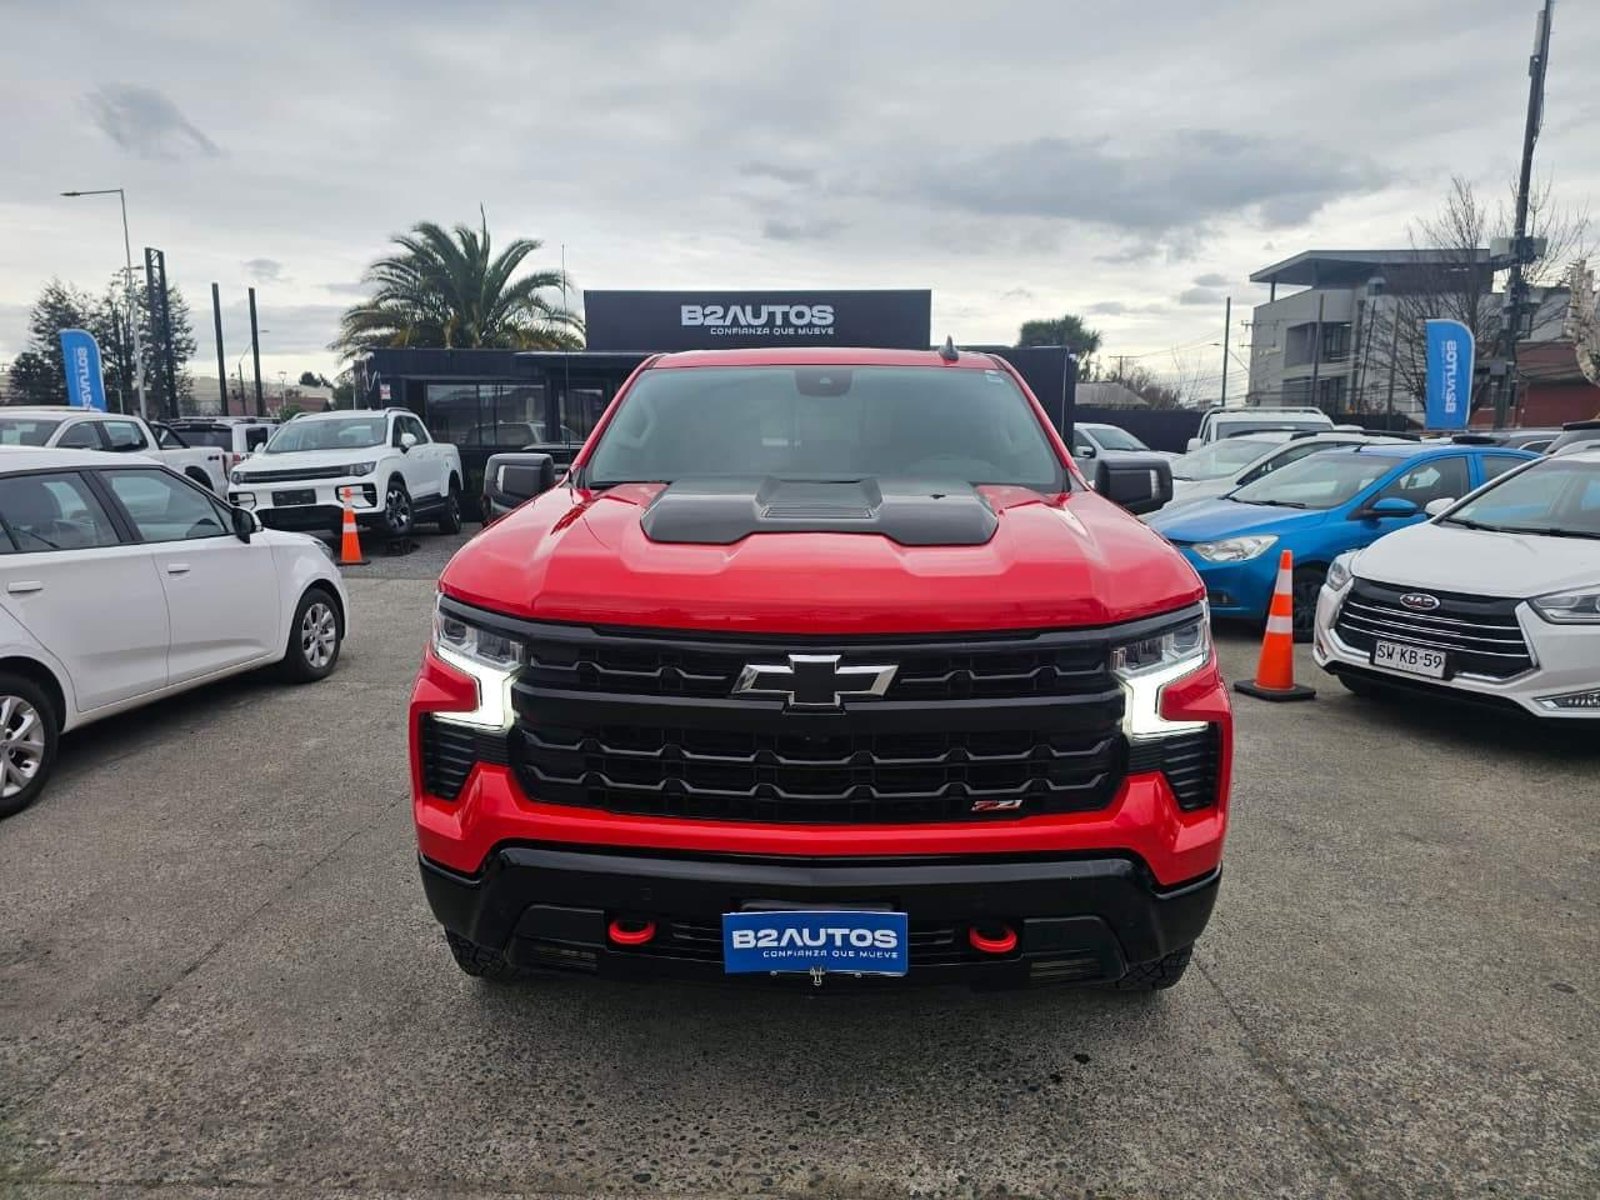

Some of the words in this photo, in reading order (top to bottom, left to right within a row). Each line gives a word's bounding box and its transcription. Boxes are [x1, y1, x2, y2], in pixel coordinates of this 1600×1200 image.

[681, 305, 835, 326] B2AUTOS
[710, 327, 770, 335] CONFIANZA
[773, 327, 795, 336] QUE
[798, 327, 835, 335] MUEVE
[732, 928, 898, 949] B2AUTOS
[763, 950, 827, 958] CONFIANZA
[832, 950, 855, 958] QUE
[859, 951, 899, 959] MUEVE
